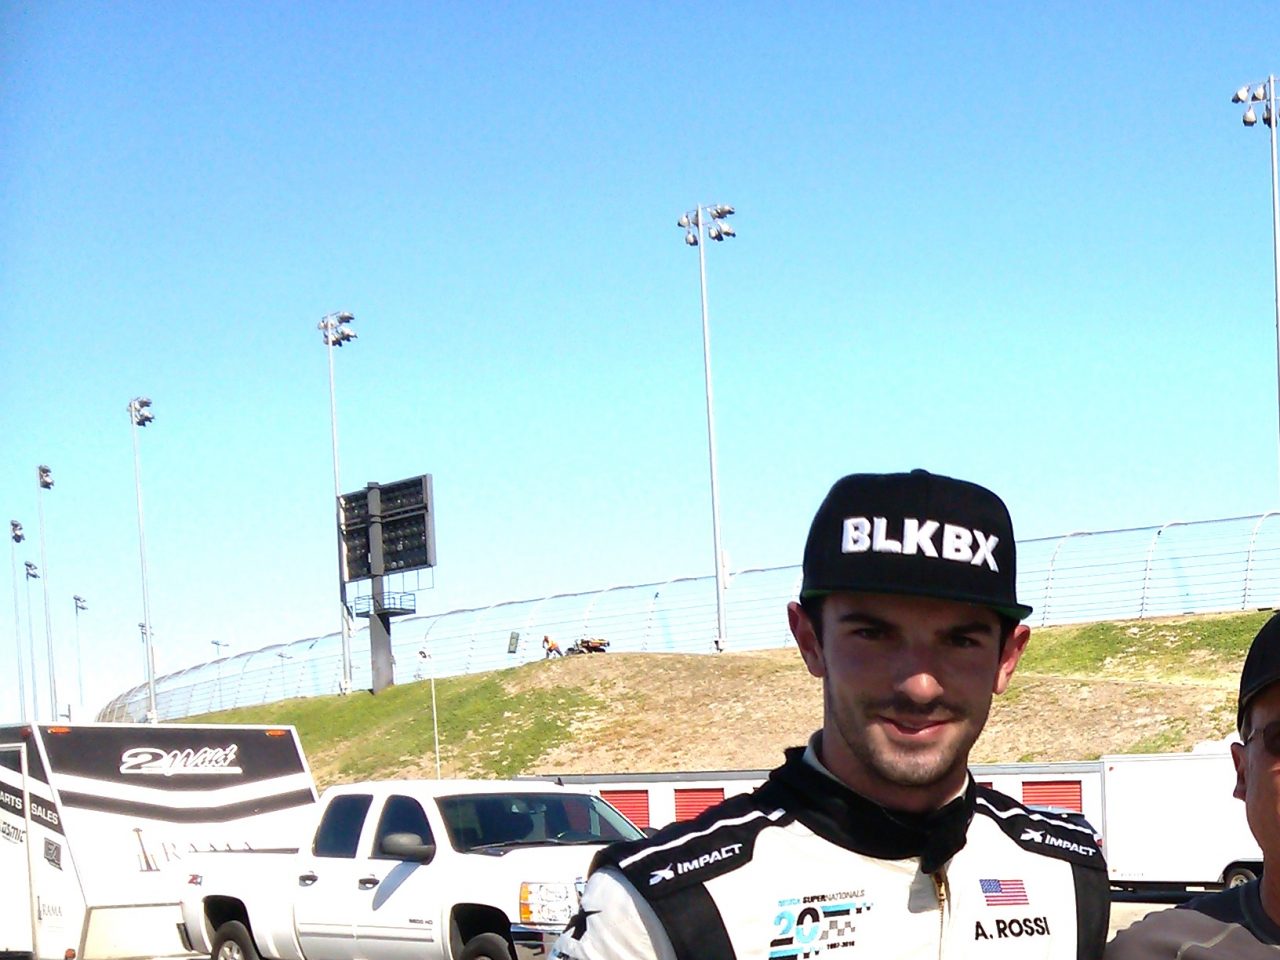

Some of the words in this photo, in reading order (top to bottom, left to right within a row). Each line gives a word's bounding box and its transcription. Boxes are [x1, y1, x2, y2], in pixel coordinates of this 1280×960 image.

[841, 516, 999, 573] BLKBX
[31, 803, 59, 825] SALES
[1044, 834, 1097, 856] IMPACT
[677, 843, 743, 875] IMPACT
[975, 920, 994, 940] A.
[995, 916, 1051, 938] ROSSI
